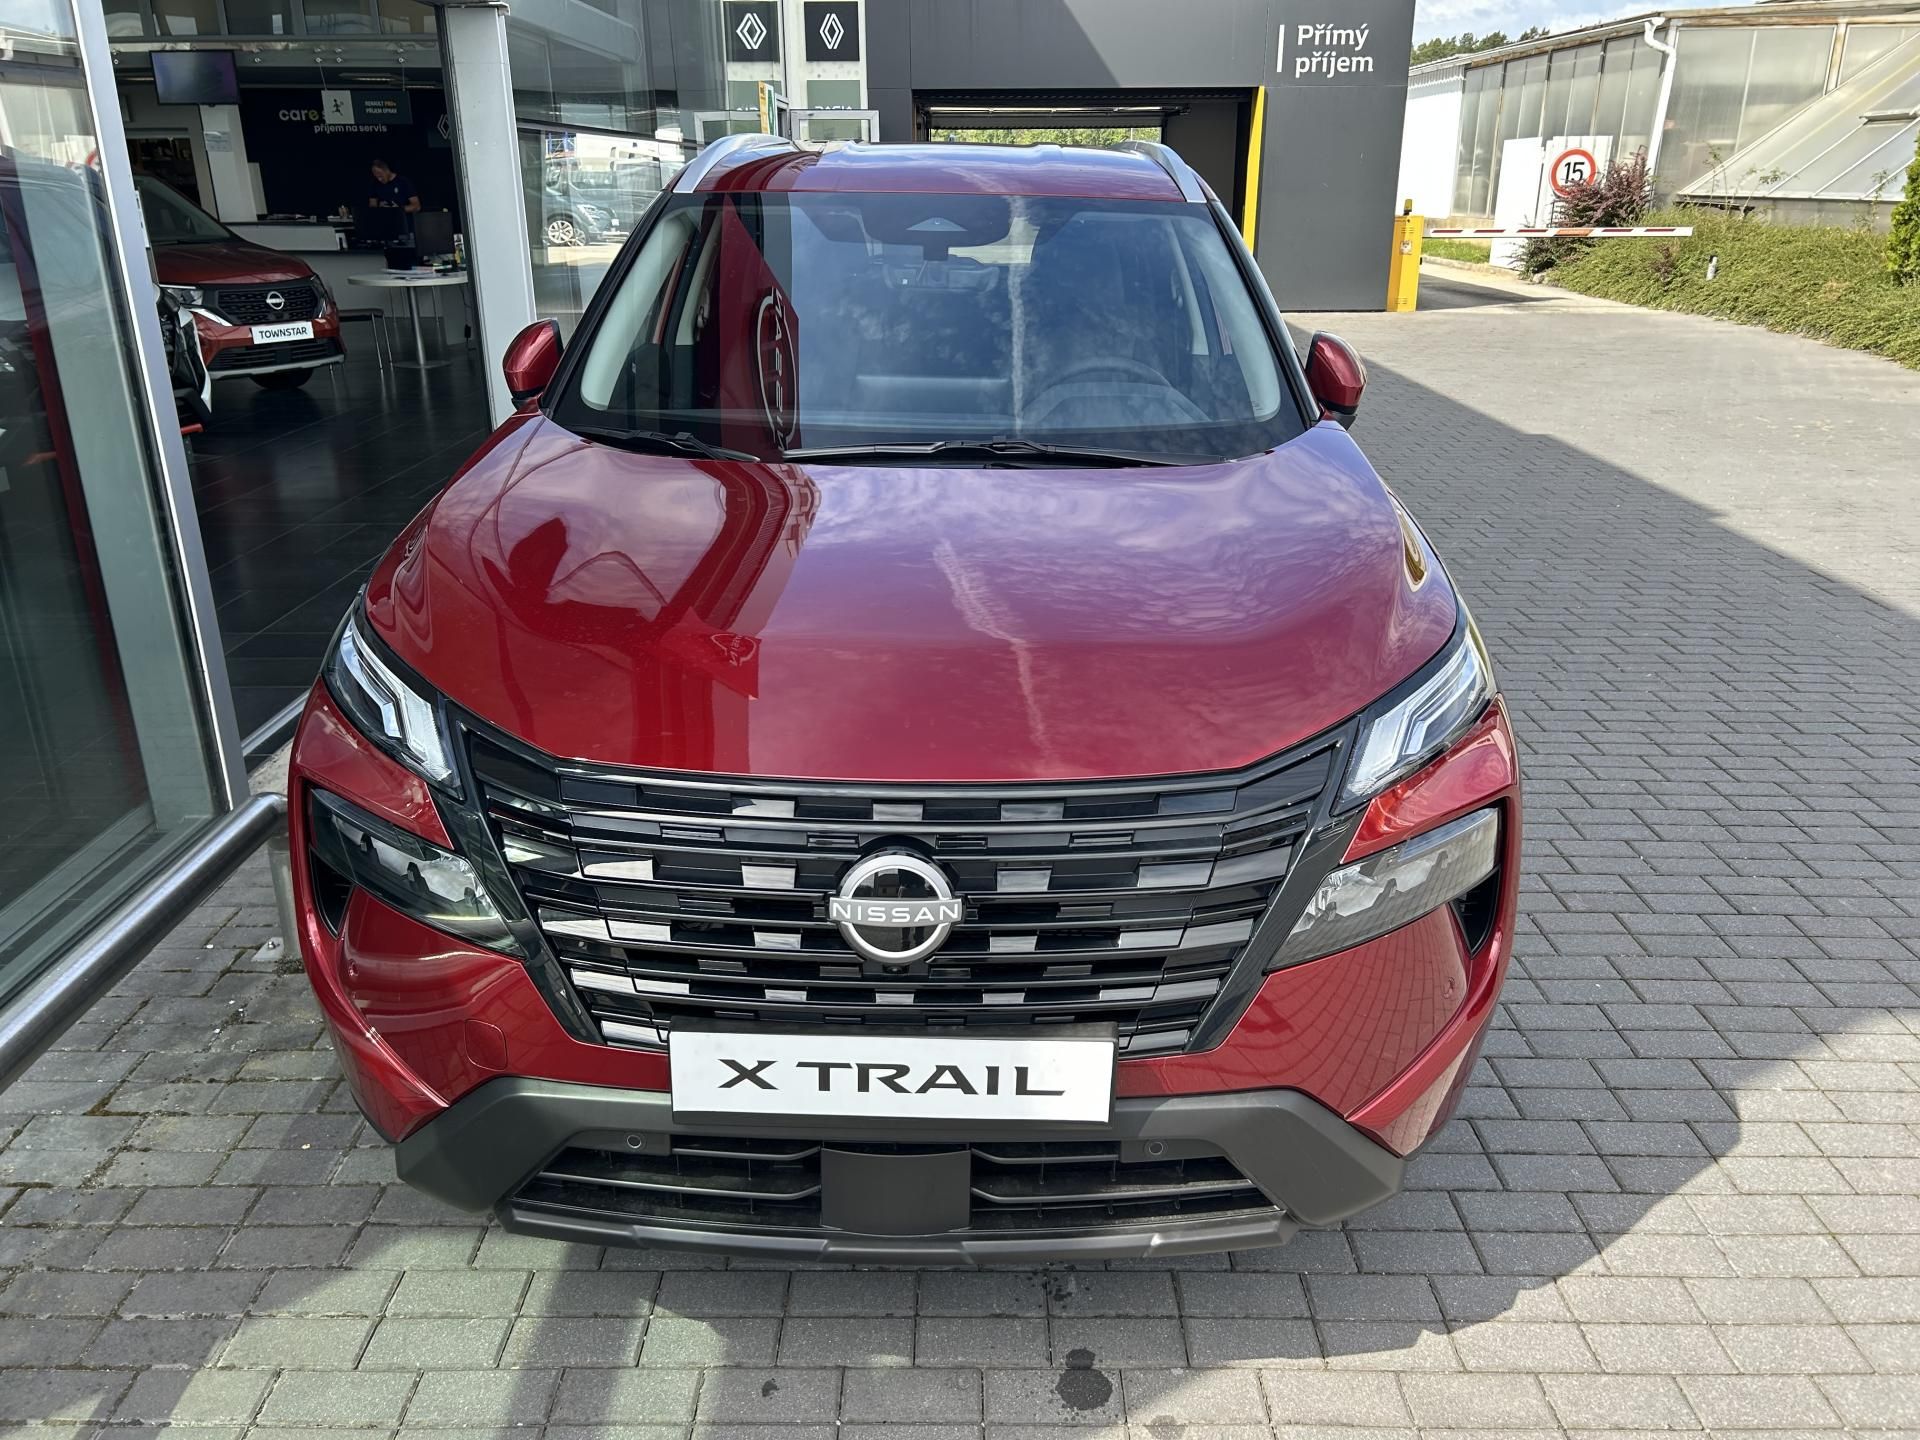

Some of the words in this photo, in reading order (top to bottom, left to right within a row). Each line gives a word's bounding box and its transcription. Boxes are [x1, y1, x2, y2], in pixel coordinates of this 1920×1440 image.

[1297, 23, 1370, 51] Přímý
[1295, 51, 1374, 78] příjem
[278, 109, 319, 121] care
[346, 124, 358, 132] na
[359, 123, 388, 132] servis
[1564, 161, 1585, 184] 15
[258, 326, 308, 339] TOWNSTAR
[832, 901, 959, 923] NISSAN
[717, 1058, 780, 1091] X
[795, 1061, 1066, 1097] TRAIL
